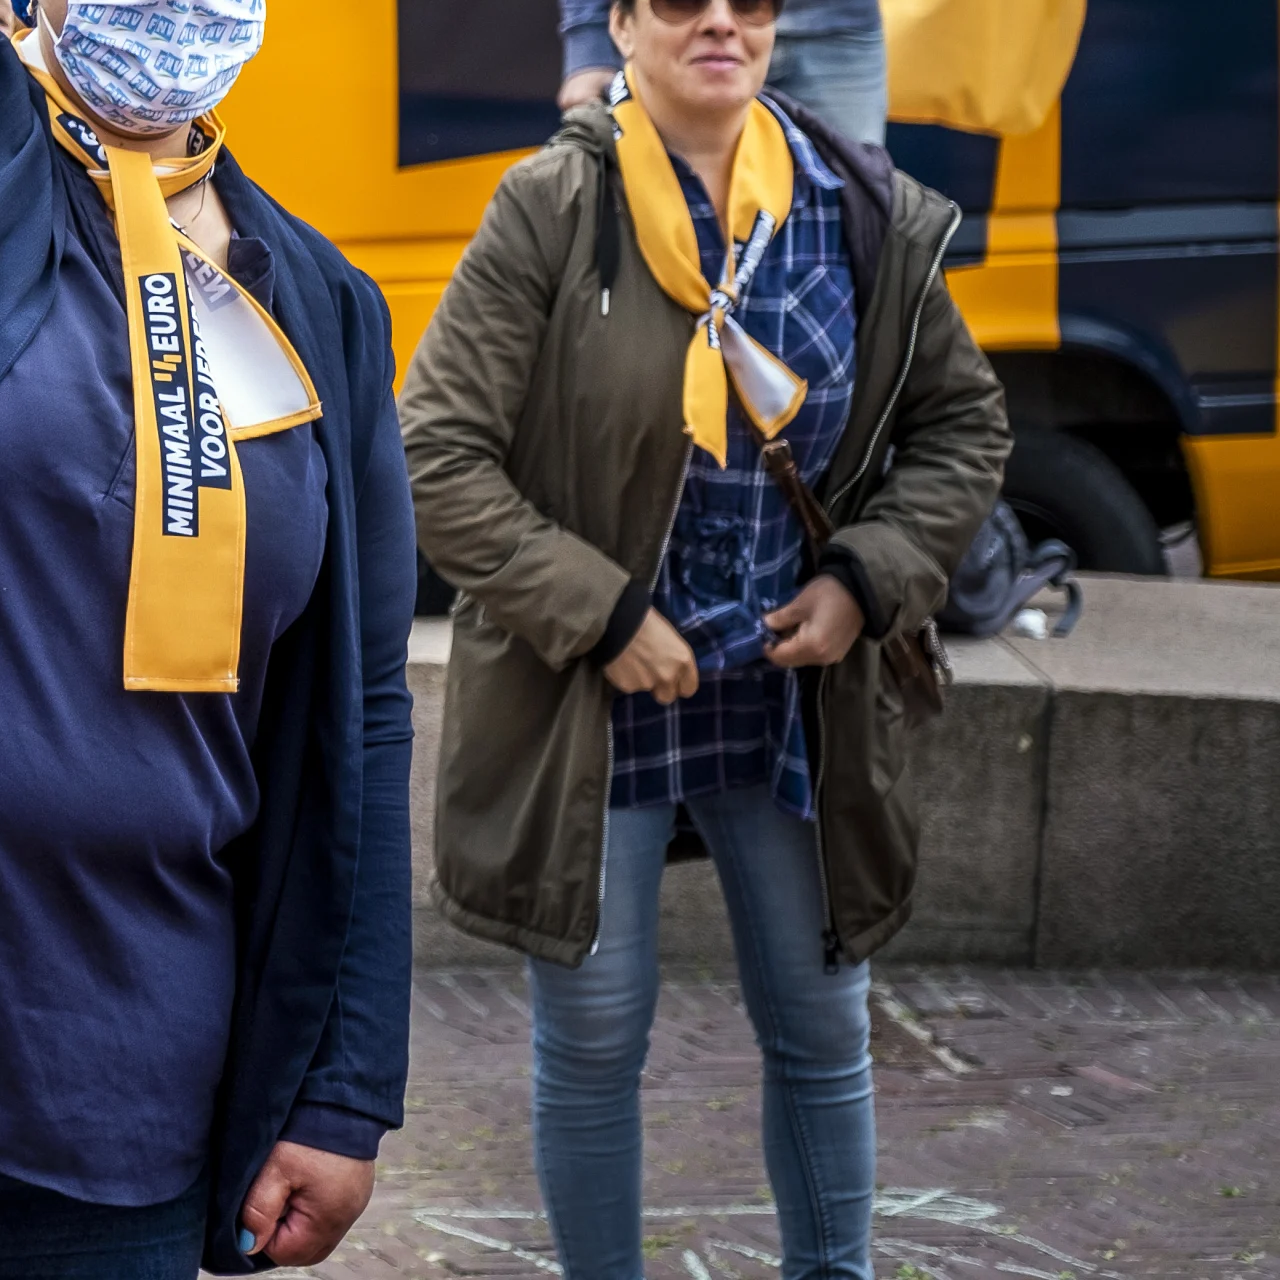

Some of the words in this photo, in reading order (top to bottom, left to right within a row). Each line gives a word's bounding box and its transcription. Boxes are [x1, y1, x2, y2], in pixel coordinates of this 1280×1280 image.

[144, 274, 181, 352] EURO
[162, 386, 195, 537] MINIMAAL
[199, 394, 228, 478] VOOR
